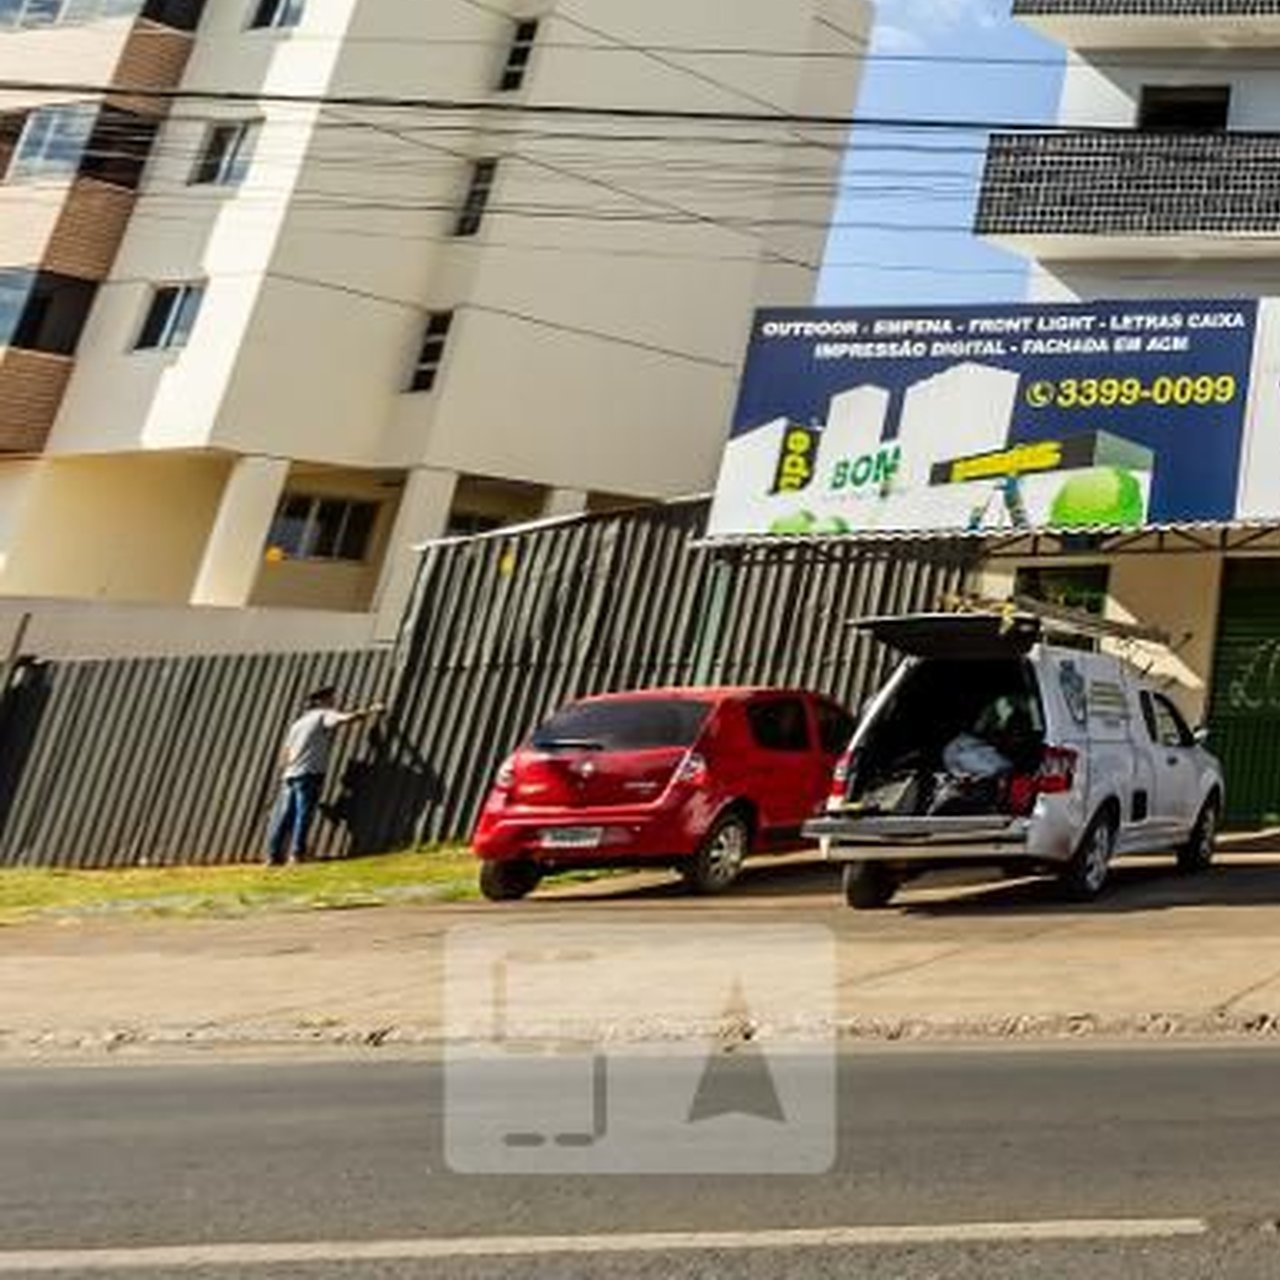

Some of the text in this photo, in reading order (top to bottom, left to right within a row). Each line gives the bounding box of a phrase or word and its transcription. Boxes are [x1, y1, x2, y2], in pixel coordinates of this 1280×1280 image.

[762, 321, 858, 336] OUTDOOR
[873, 320, 953, 335] EMPENA
[969, 318, 1035, 334] FRONT
[1037, 316, 1096, 331] LIGHT
[1110, 314, 1183, 330] LETRAS
[1188, 313, 1244, 329] CAIXA
[814, 340, 927, 358] IMPRESSÃO
[931, 340, 1006, 357] DIGITAL
[1022, 338, 1109, 354] FACHADA
[1114, 337, 1142, 352] EM
[1146, 336, 1189, 352] ACM
[1056, 375, 1236, 406] 3399-0099
